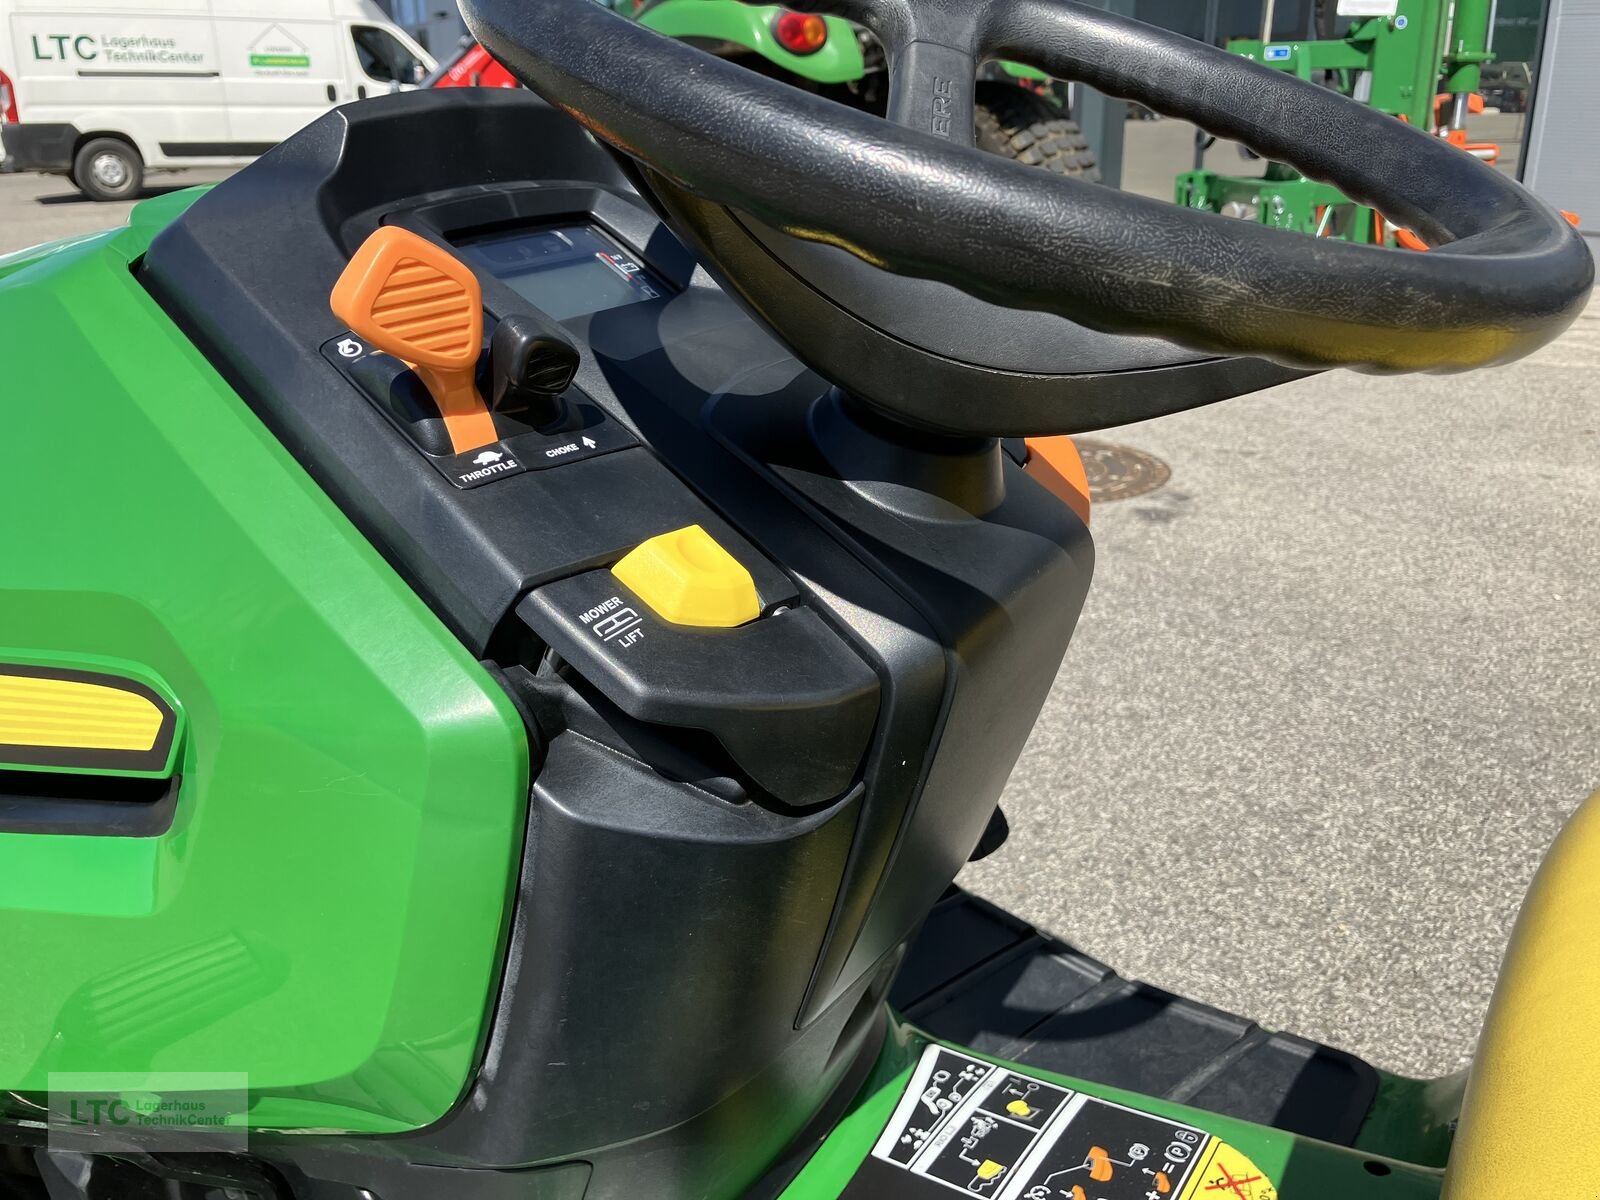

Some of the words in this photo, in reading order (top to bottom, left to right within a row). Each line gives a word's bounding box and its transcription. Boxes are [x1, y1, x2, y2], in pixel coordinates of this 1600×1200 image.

[32, 35, 97, 60] LTC
[101, 34, 176, 49] Lagerhaus
[105, 49, 204, 63] TechnikCenter
[545, 443, 580, 458] CHOKE
[459, 459, 518, 484] THROTTLE
[578, 596, 624, 624] MOWER
[618, 628, 645, 648] LIFT
